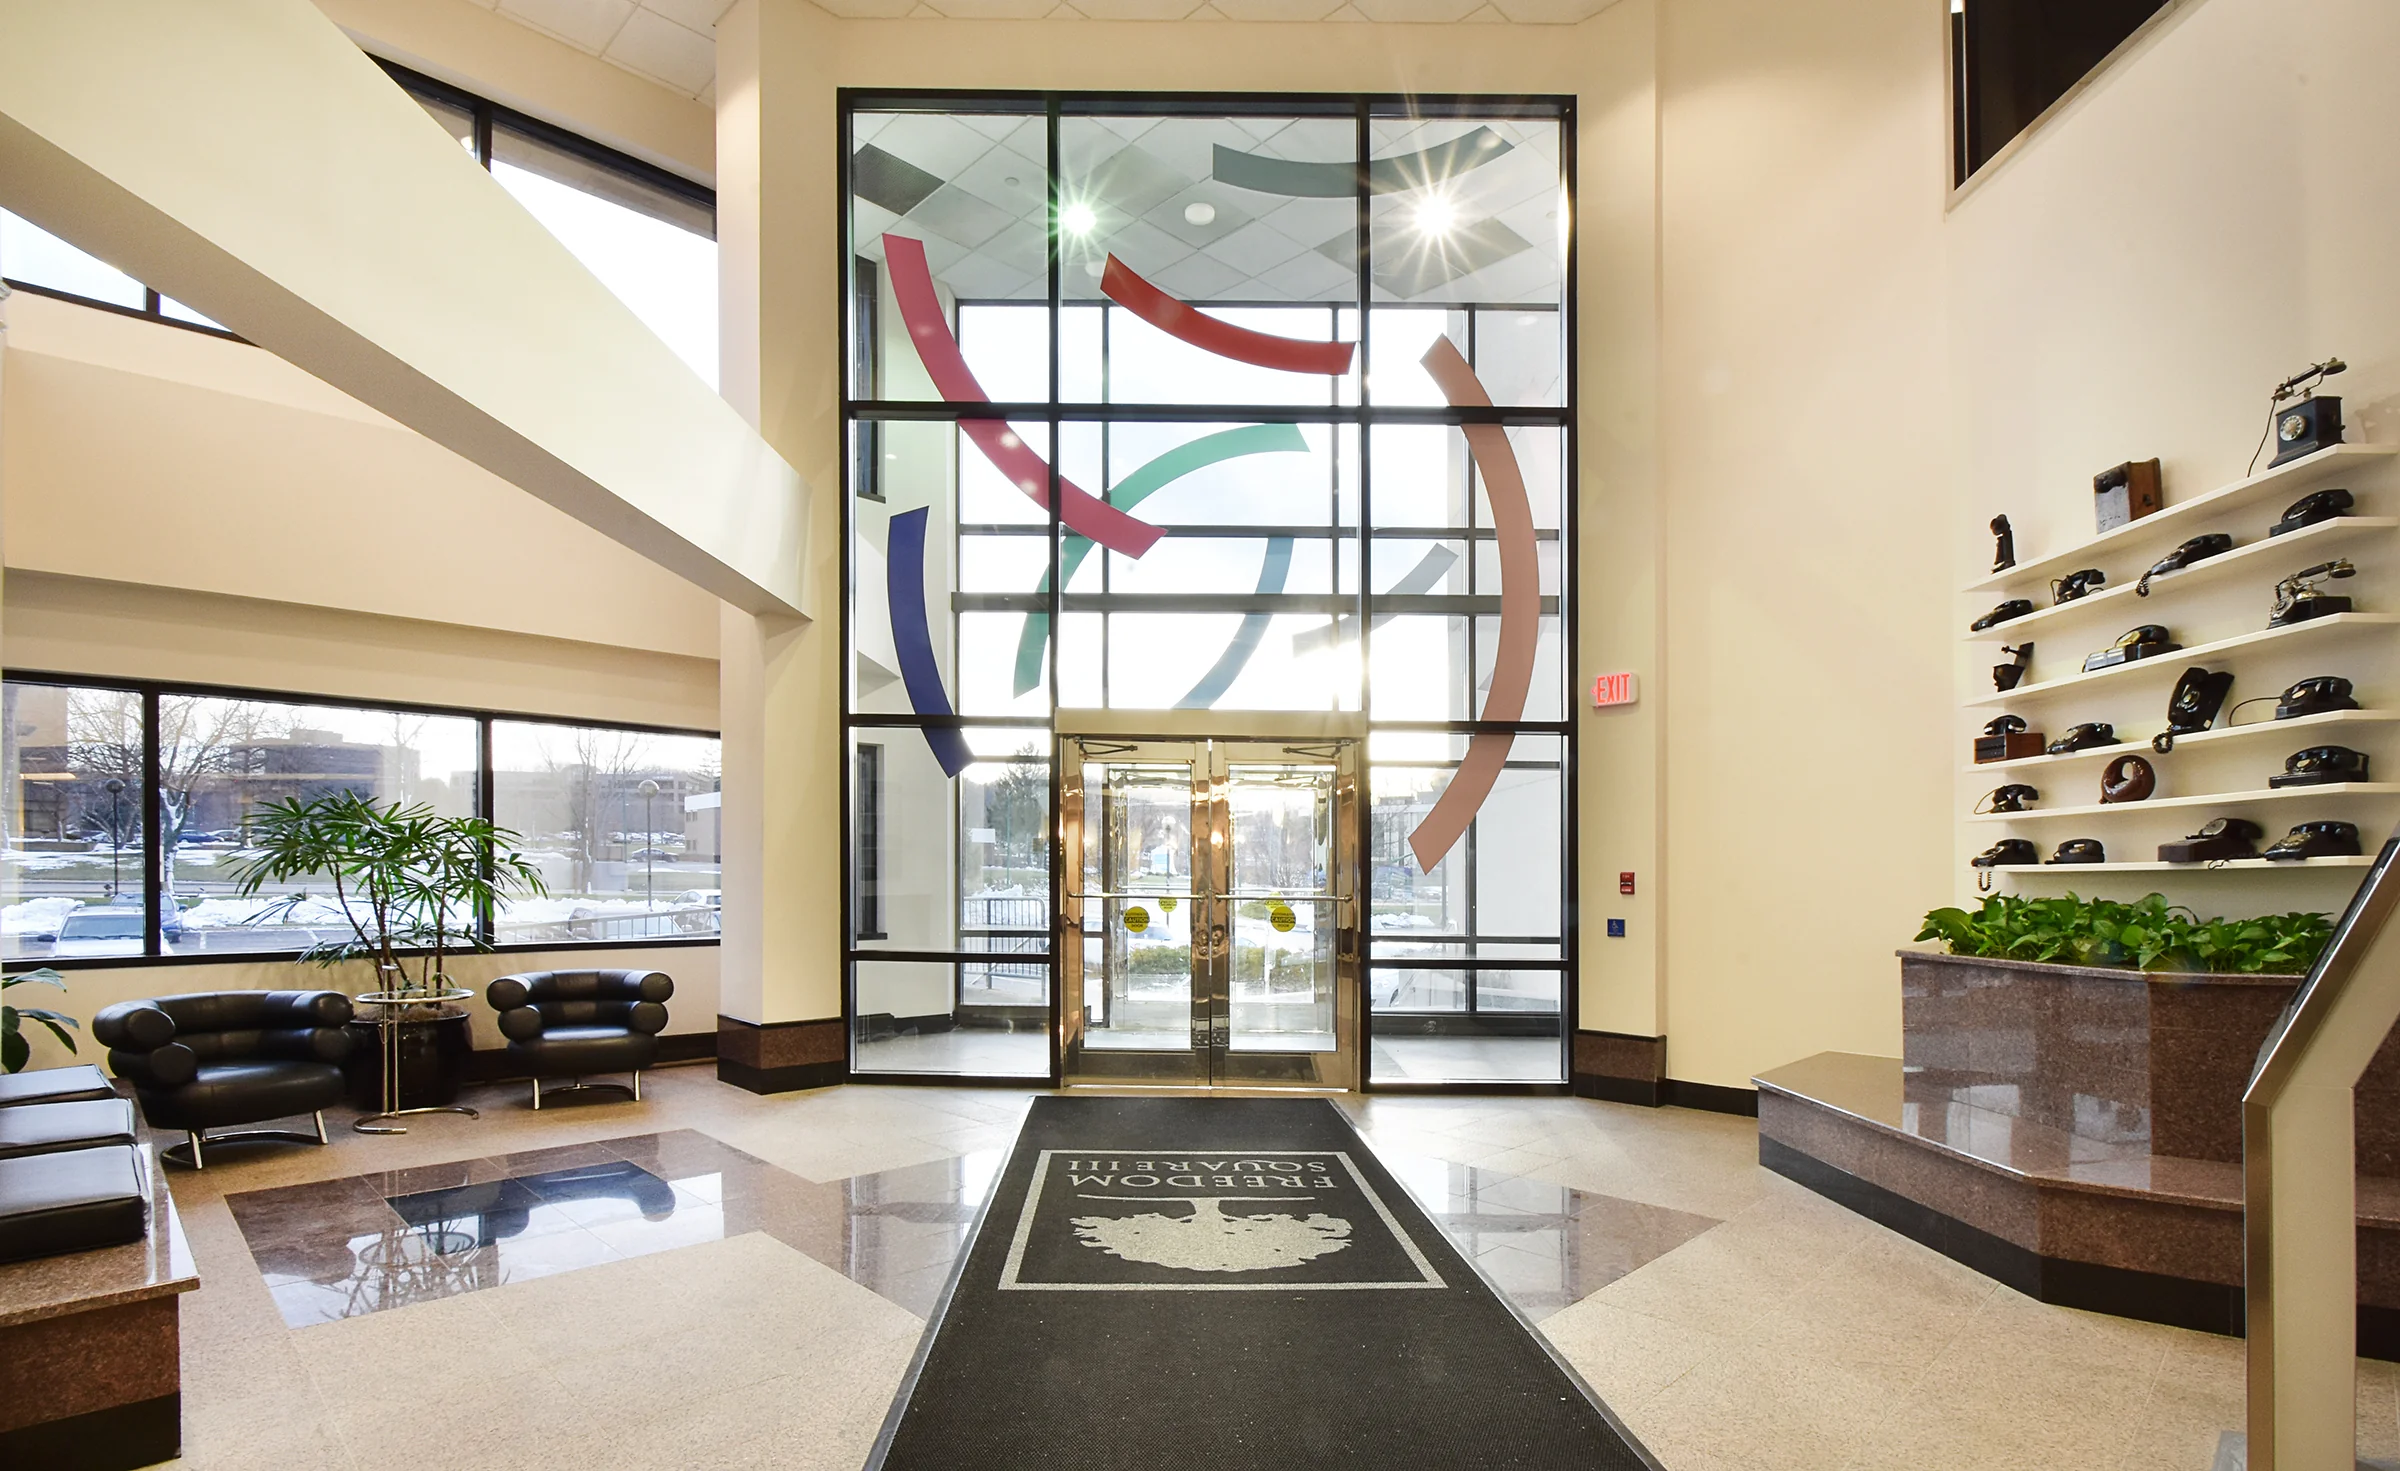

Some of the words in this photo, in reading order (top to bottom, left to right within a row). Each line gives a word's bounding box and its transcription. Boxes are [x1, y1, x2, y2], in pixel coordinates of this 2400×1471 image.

[1597, 673, 1630, 704] EXIT
[1069, 1160, 1120, 1171] III
[1136, 1160, 1326, 1172] SQUARE
[1067, 1174, 1339, 1188] FREEDOM
